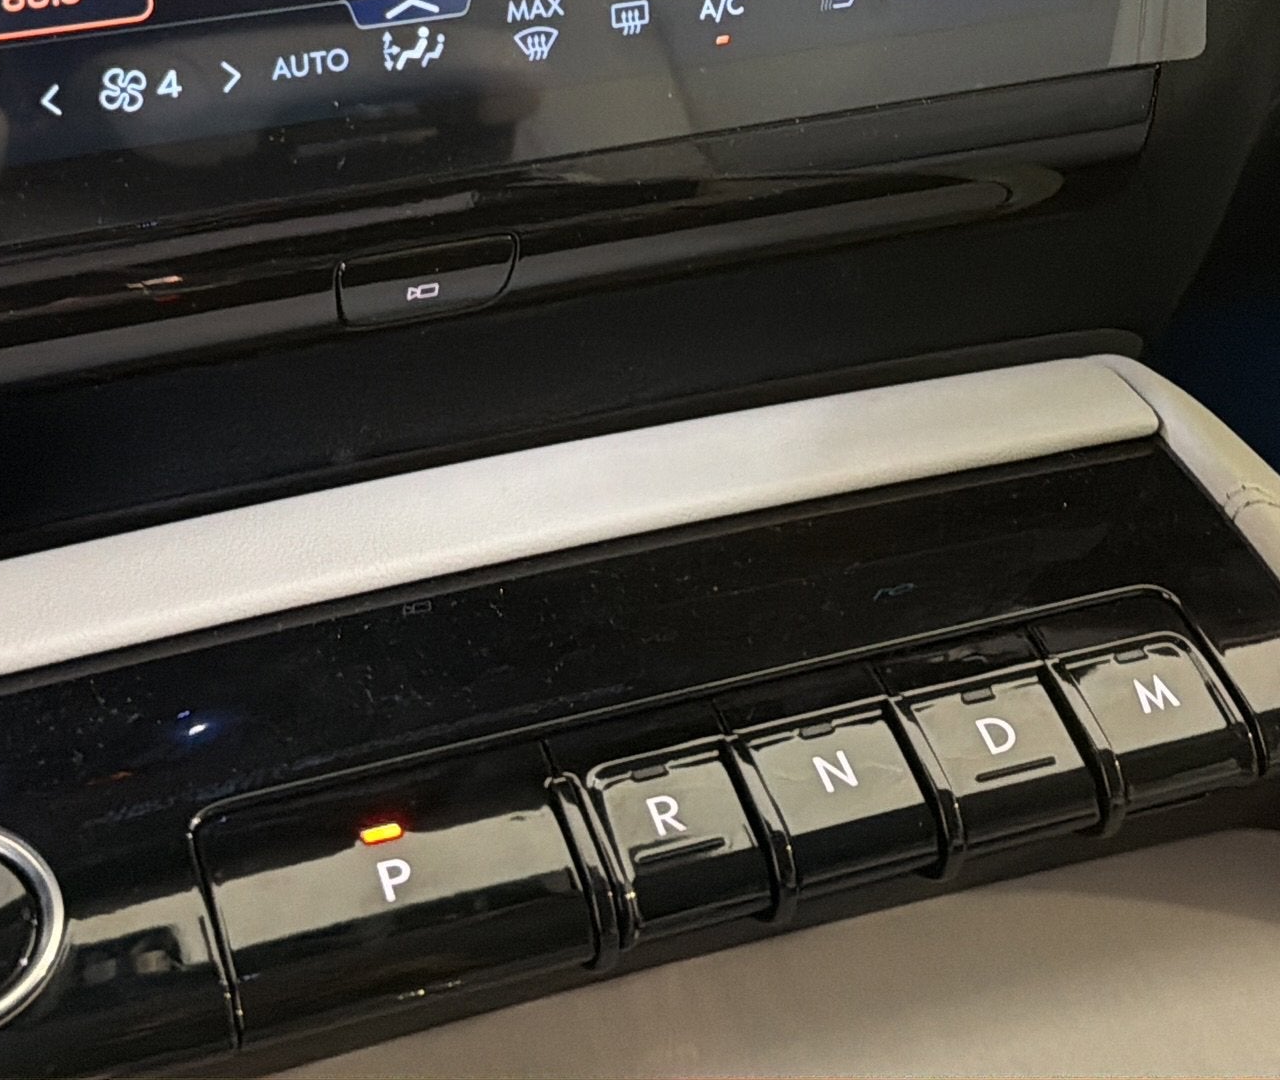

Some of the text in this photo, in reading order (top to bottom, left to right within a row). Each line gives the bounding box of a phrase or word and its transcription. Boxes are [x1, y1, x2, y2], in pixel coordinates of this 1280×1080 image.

[155, 69, 184, 100] 4
[271, 47, 350, 83] AUTO
[1133, 674, 1184, 716] M
[975, 717, 1017, 757] D
[811, 749, 860, 794] N
[647, 794, 688, 837] R
[375, 858, 413, 903] P
